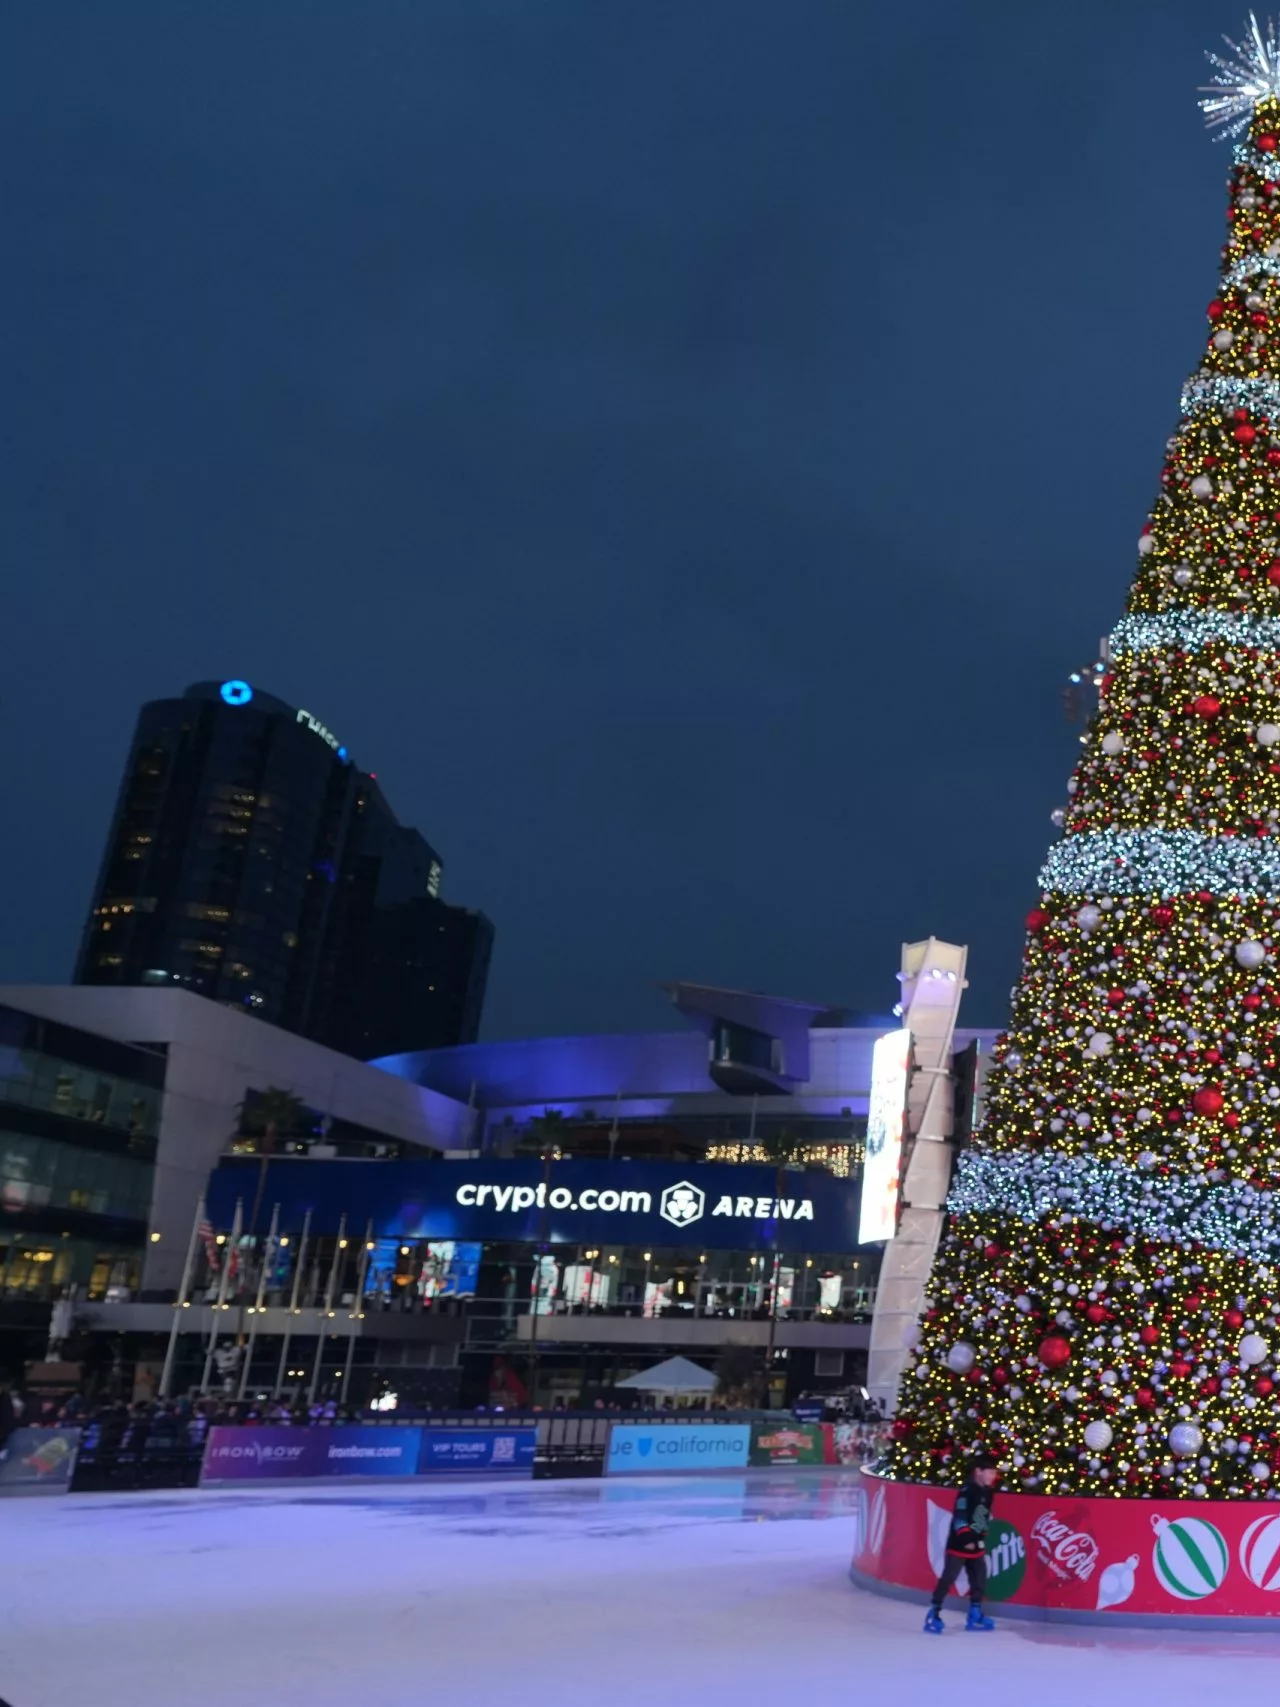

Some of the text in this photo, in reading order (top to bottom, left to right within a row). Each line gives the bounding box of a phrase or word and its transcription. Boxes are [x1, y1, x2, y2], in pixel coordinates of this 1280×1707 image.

[456, 1182, 814, 1220] crypto.com ARENA
[212, 1445, 304, 1458] IRON BOW
[328, 1444, 402, 1458] ironbow.com
[433, 1442, 486, 1453] VIP TOURS
[656, 1433, 744, 1455] california
[984, 1531, 1026, 1579] rite
